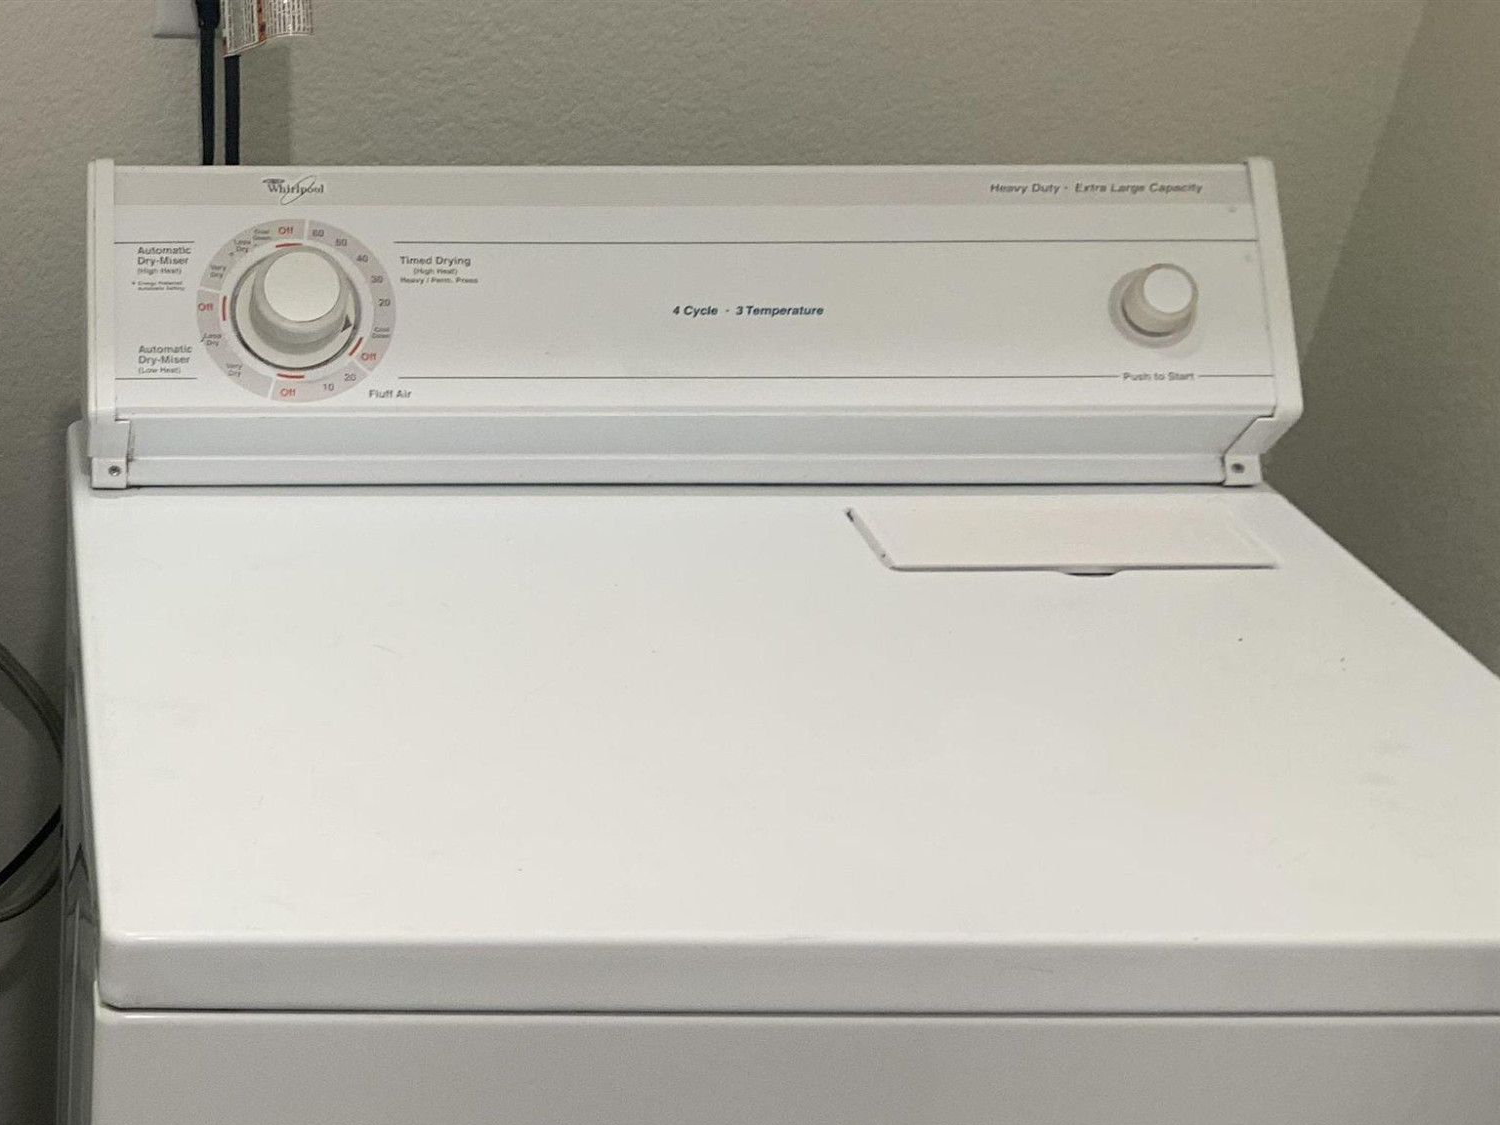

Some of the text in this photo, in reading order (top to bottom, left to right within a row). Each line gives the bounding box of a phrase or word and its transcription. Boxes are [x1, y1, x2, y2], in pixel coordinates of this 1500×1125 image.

[990, 183, 1203, 195] Heavy Duty Extra Large Capacity
[278, 226, 294, 236] Off
[335, 238, 348, 247] 50
[137, 246, 192, 255] Automatic
[137, 256, 189, 267] Dry-Miser
[356, 254, 369, 264] 40
[400, 256, 472, 267] Timed Drying
[371, 275, 383, 284] 30
[400, 276, 425, 285] Heavy
[198, 302, 214, 312] Off
[379, 298, 391, 307] 20
[672, 305, 825, 318] 4 Cycle 3 Temperature
[138, 345, 193, 354] Automatic
[138, 355, 190, 367] Dry-Miser
[360, 352, 377, 361] Off
[138, 366, 159, 375] (Low
[344, 373, 357, 382] 20
[1123, 372, 1194, 381] Push to Start
[323, 383, 335, 391] 10
[280, 388, 296, 397] Off
[369, 389, 412, 399] Fluff Air
